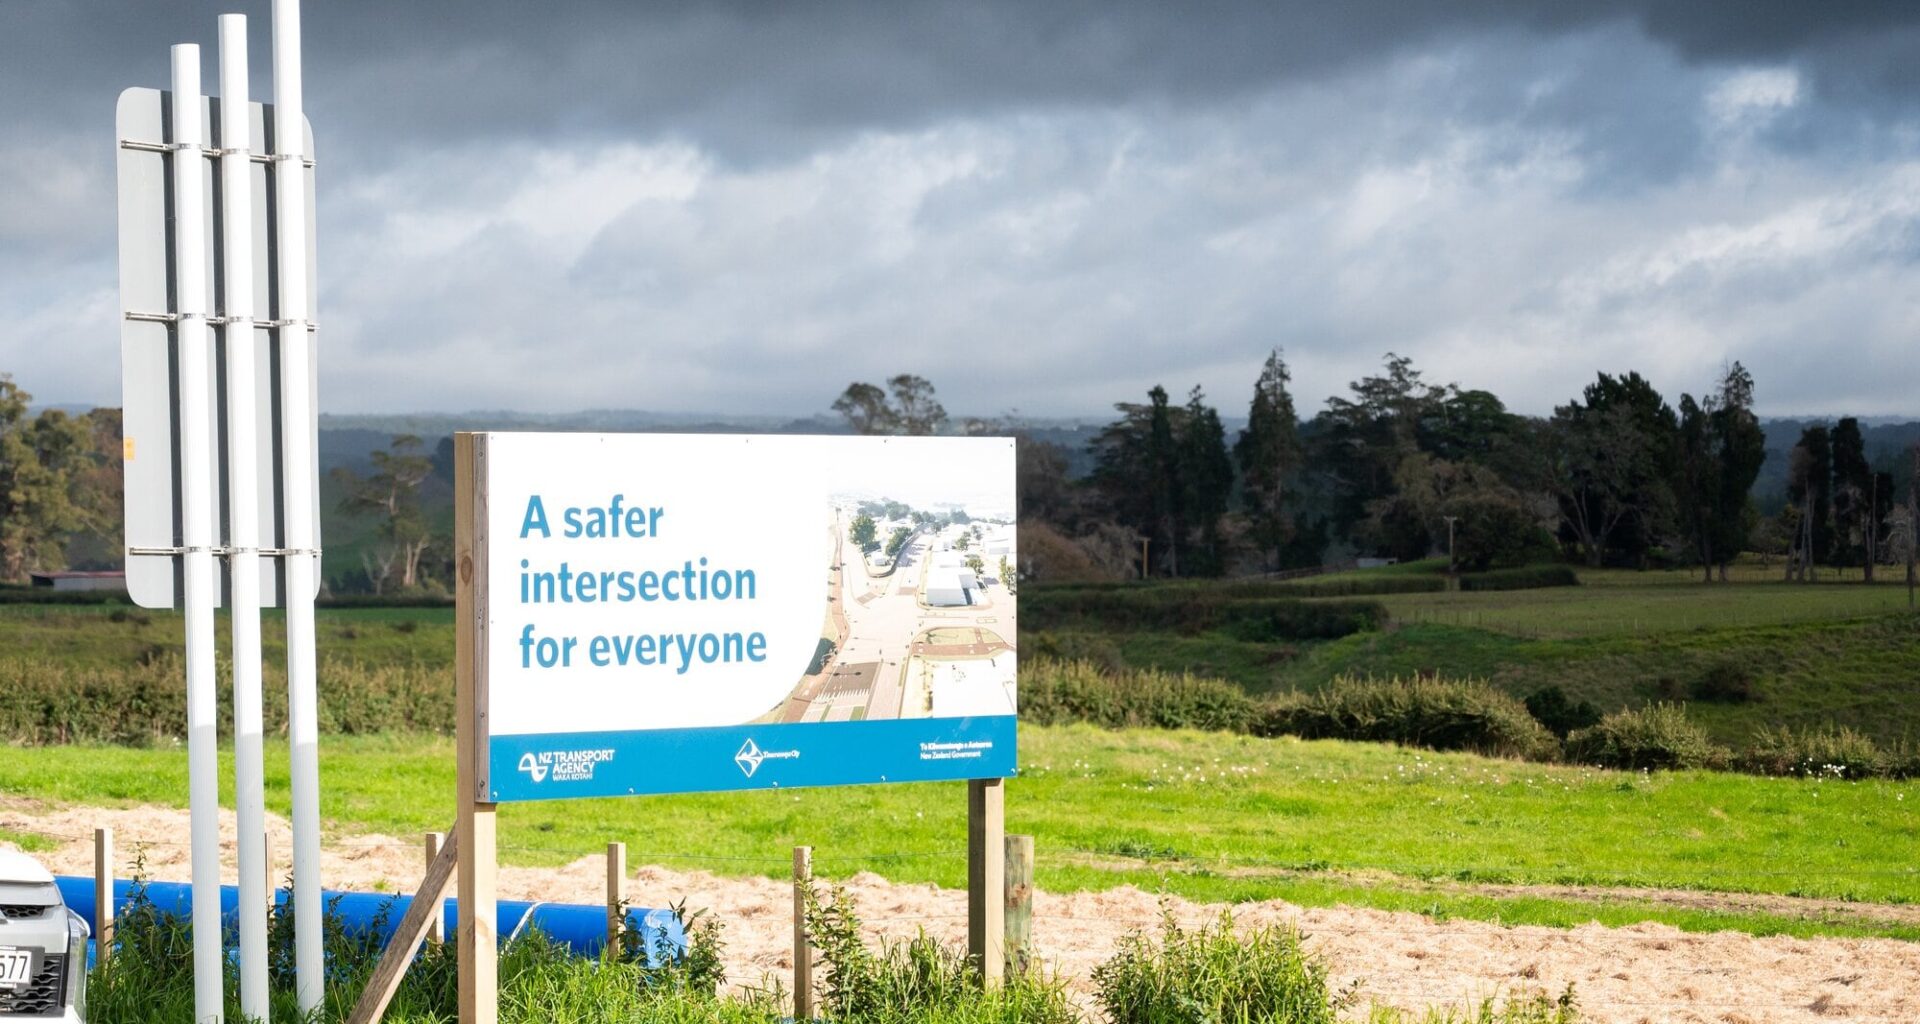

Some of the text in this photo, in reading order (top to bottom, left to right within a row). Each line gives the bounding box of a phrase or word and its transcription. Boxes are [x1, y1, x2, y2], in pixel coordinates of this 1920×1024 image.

[519, 493, 664, 538] A safer
[520, 556, 756, 603] intersection
[519, 624, 767, 675] for everyone
[538, 749, 615, 764] NZ TRANSPORT
[552, 761, 595, 774] AGENCY
[552, 772, 570, 782] WAKA
